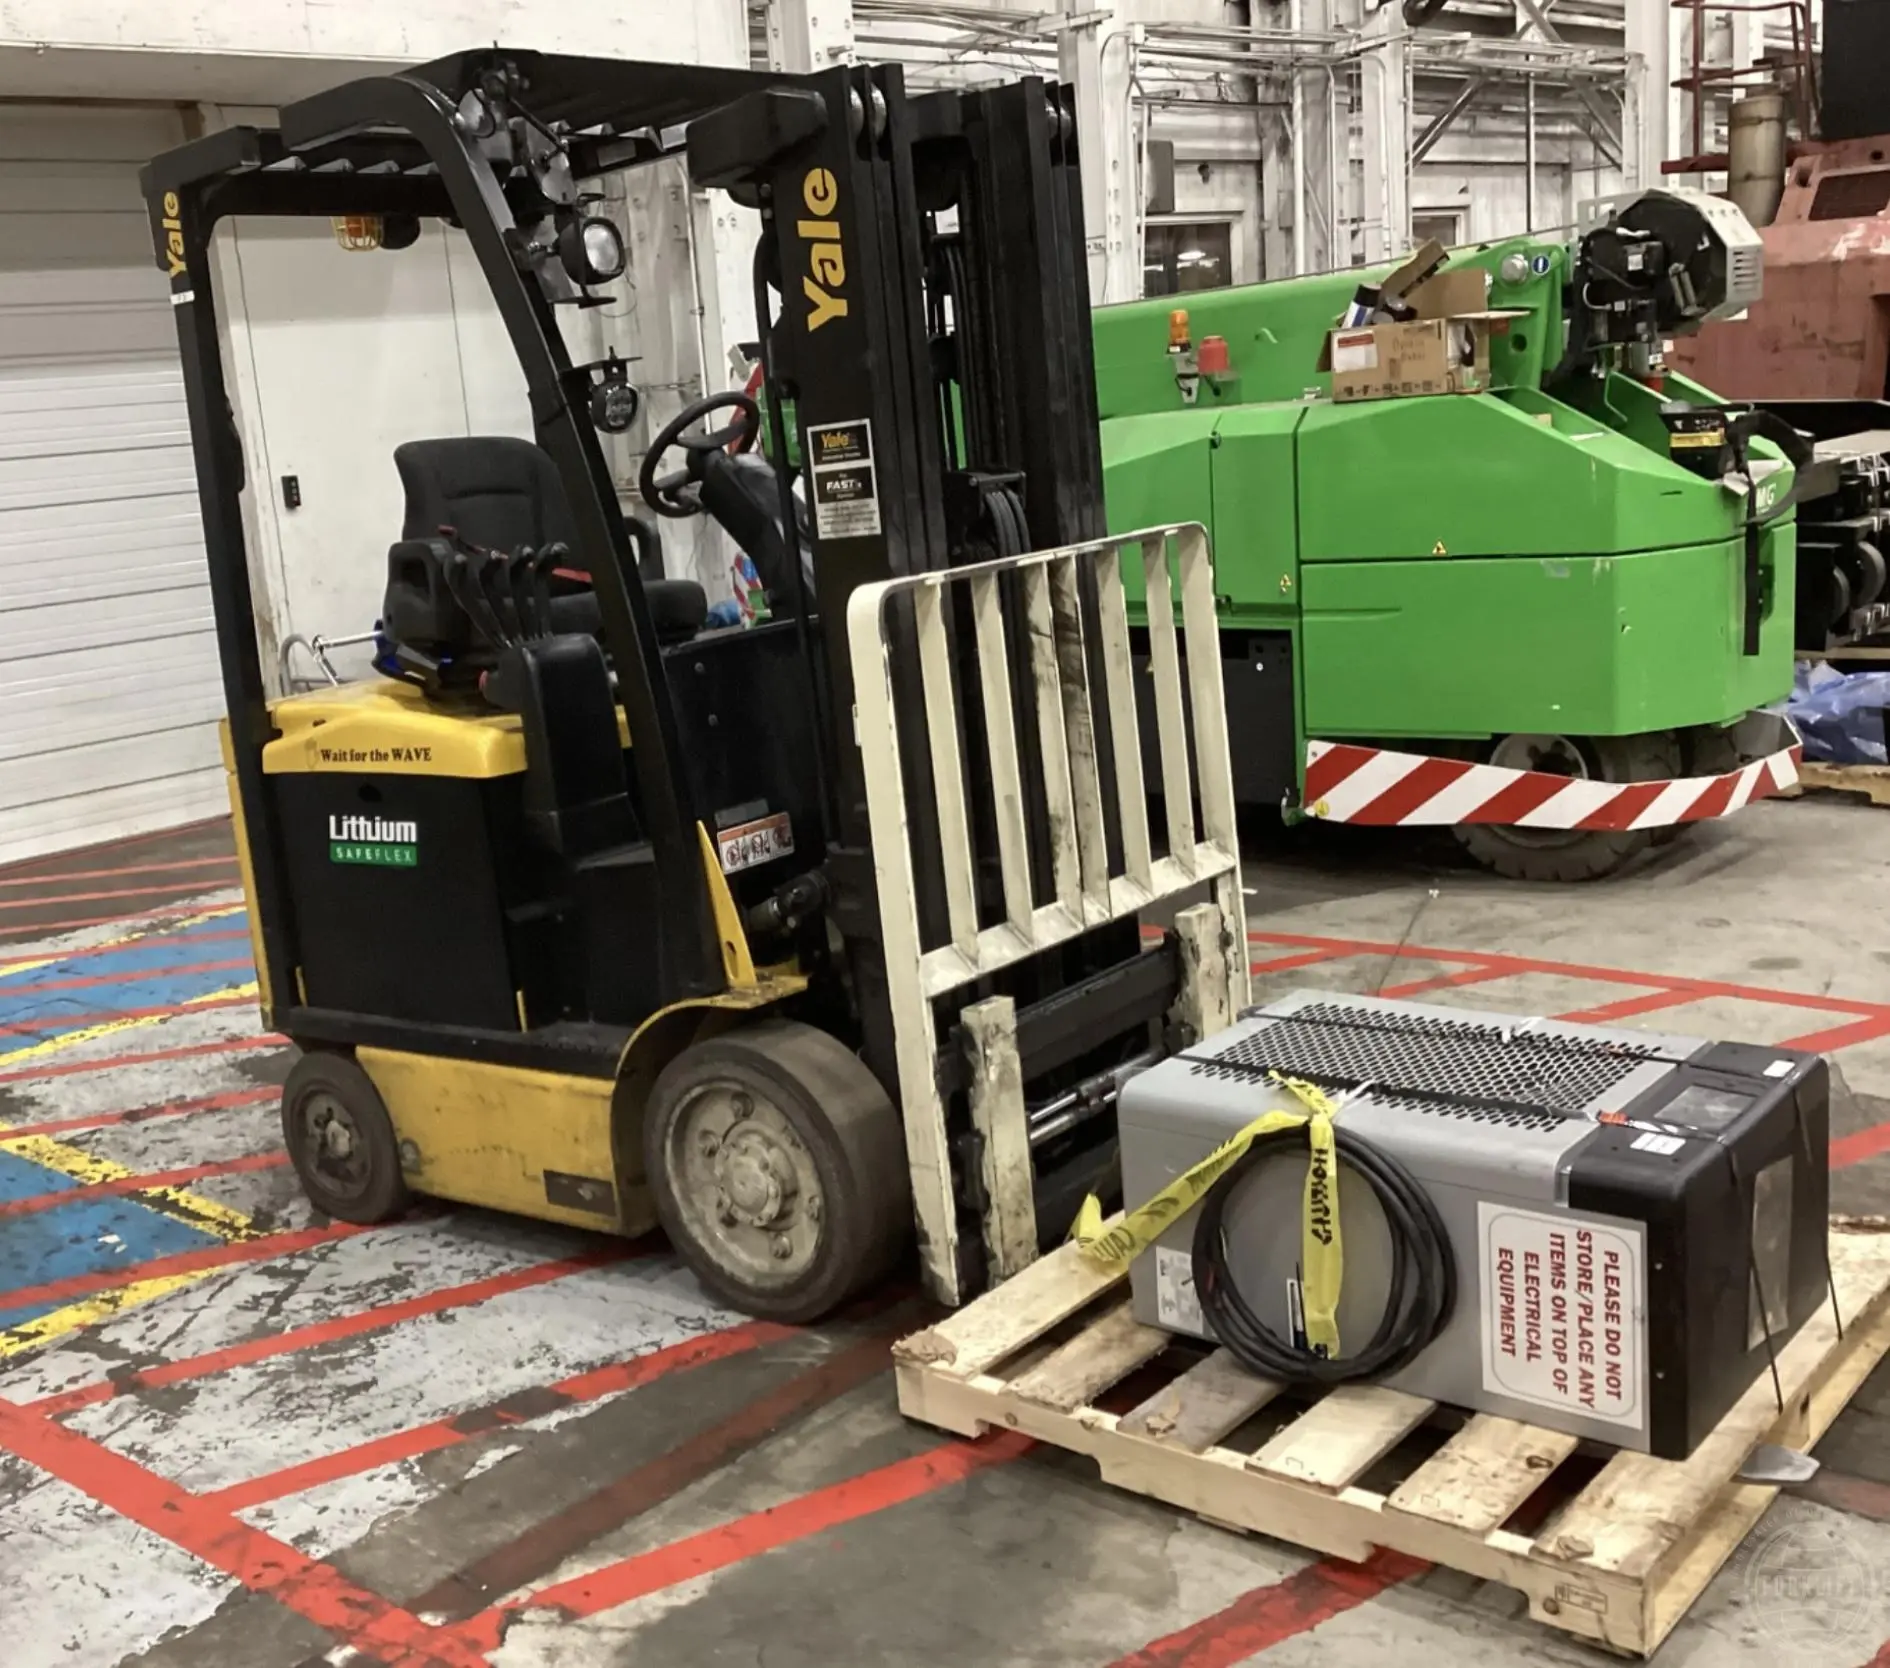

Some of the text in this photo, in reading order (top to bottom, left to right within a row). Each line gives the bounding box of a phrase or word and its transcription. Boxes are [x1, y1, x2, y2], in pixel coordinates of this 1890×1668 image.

[162, 191, 187, 278] Yale
[797, 168, 848, 332] Yale
[320, 747, 432, 762] Wait for the WAVE
[329, 815, 417, 843] Lithium
[336, 847, 412, 862] SAFEFLEX
[1497, 1247, 1516, 1357] EQUIPMENT
[1524, 1251, 1542, 1362] ELECTRICAL
[1550, 1233, 1568, 1395] ITEMS ON TOP OF
[1575, 1229, 1595, 1409] STORE/PLACE ANY
[1604, 1250, 1621, 1401] PLEASE DO NOT
